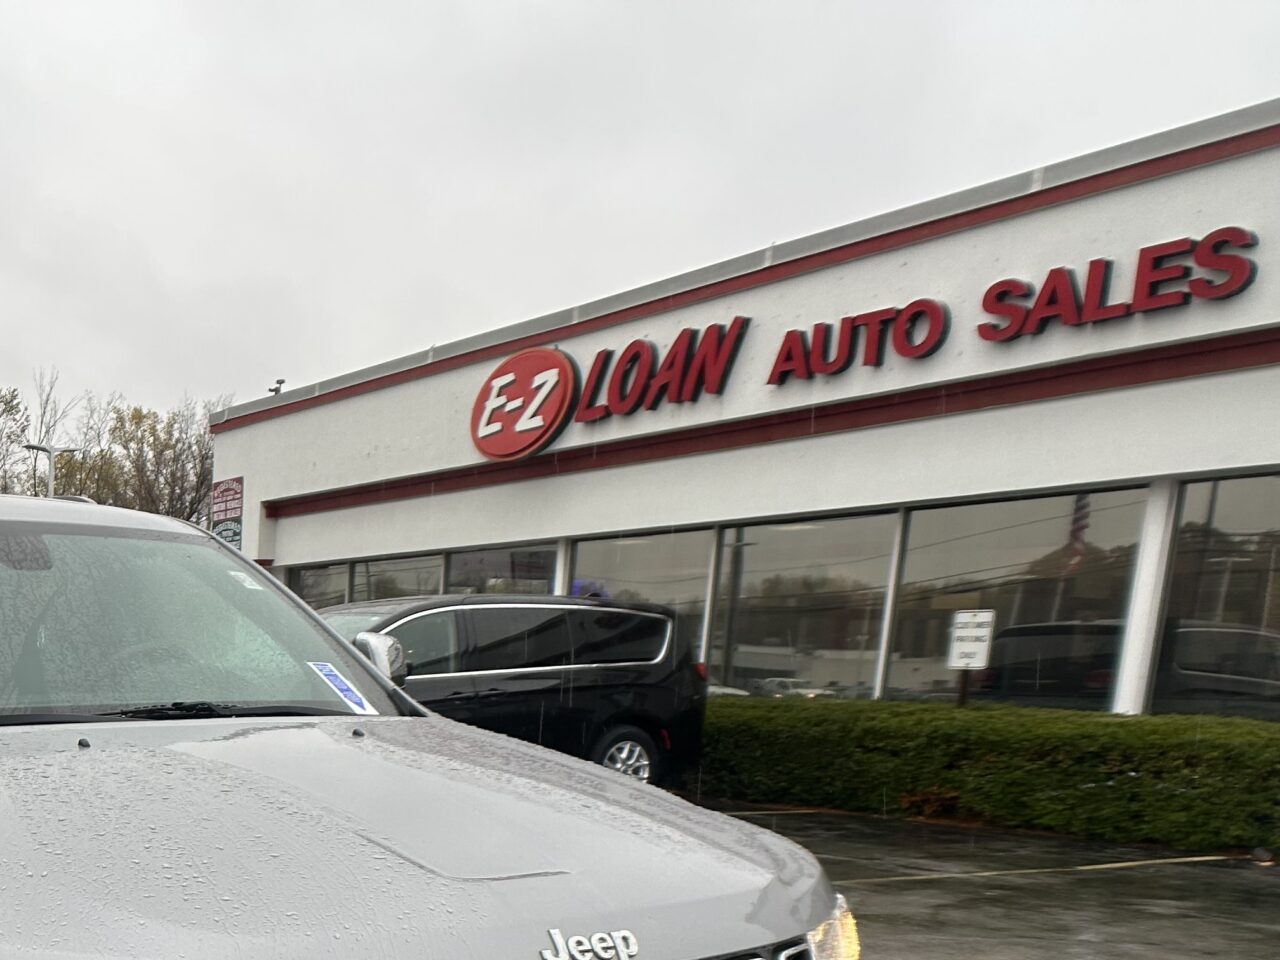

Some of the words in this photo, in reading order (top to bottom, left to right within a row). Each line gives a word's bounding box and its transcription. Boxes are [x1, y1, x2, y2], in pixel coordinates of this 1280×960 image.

[478, 368, 560, 438] E-Z
[575, 315, 749, 422] LOAN
[767, 299, 949, 385] AUTO
[977, 226, 1256, 342] SALES
